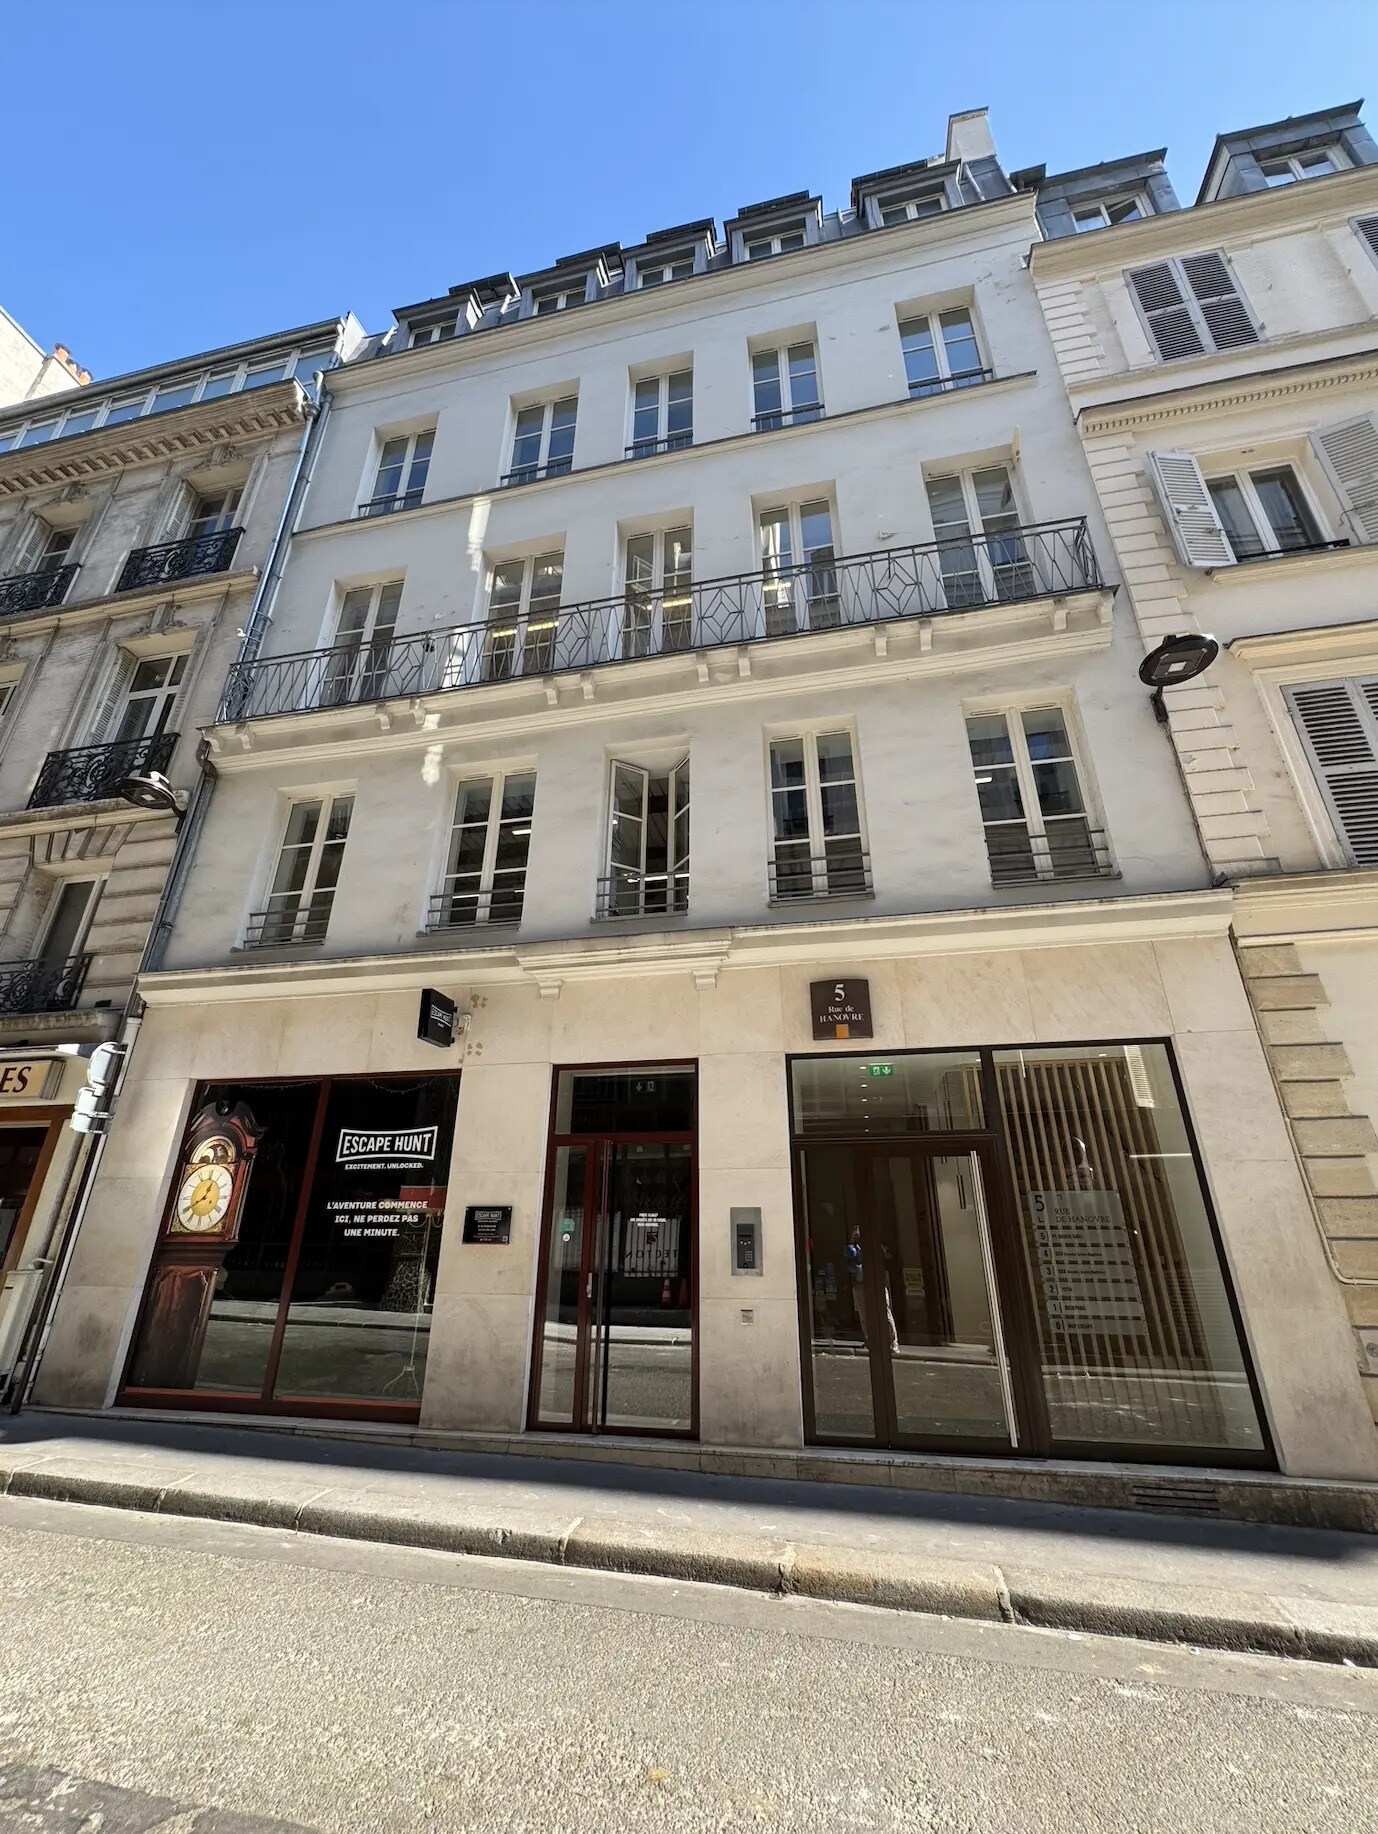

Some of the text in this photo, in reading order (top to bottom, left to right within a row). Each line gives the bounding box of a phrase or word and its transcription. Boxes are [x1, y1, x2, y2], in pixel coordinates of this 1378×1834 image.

[834, 983, 845, 1001] 5
[819, 1013, 864, 1023] HANOVRE
[342, 1133, 432, 1155] ESCAPE HUNT
[327, 1200, 428, 1210] L'AVENTURE COMMENCE
[1034, 1194, 1045, 1212] 5
[334, 1214, 419, 1224] ICI, NE PERDEZ PAS
[343, 1229, 400, 1237] UNE MINUTE.
[1040, 1232, 1046, 1240] 5
[1046, 1267, 1052, 1275] 3
[1049, 1285, 1054, 1293] 2
